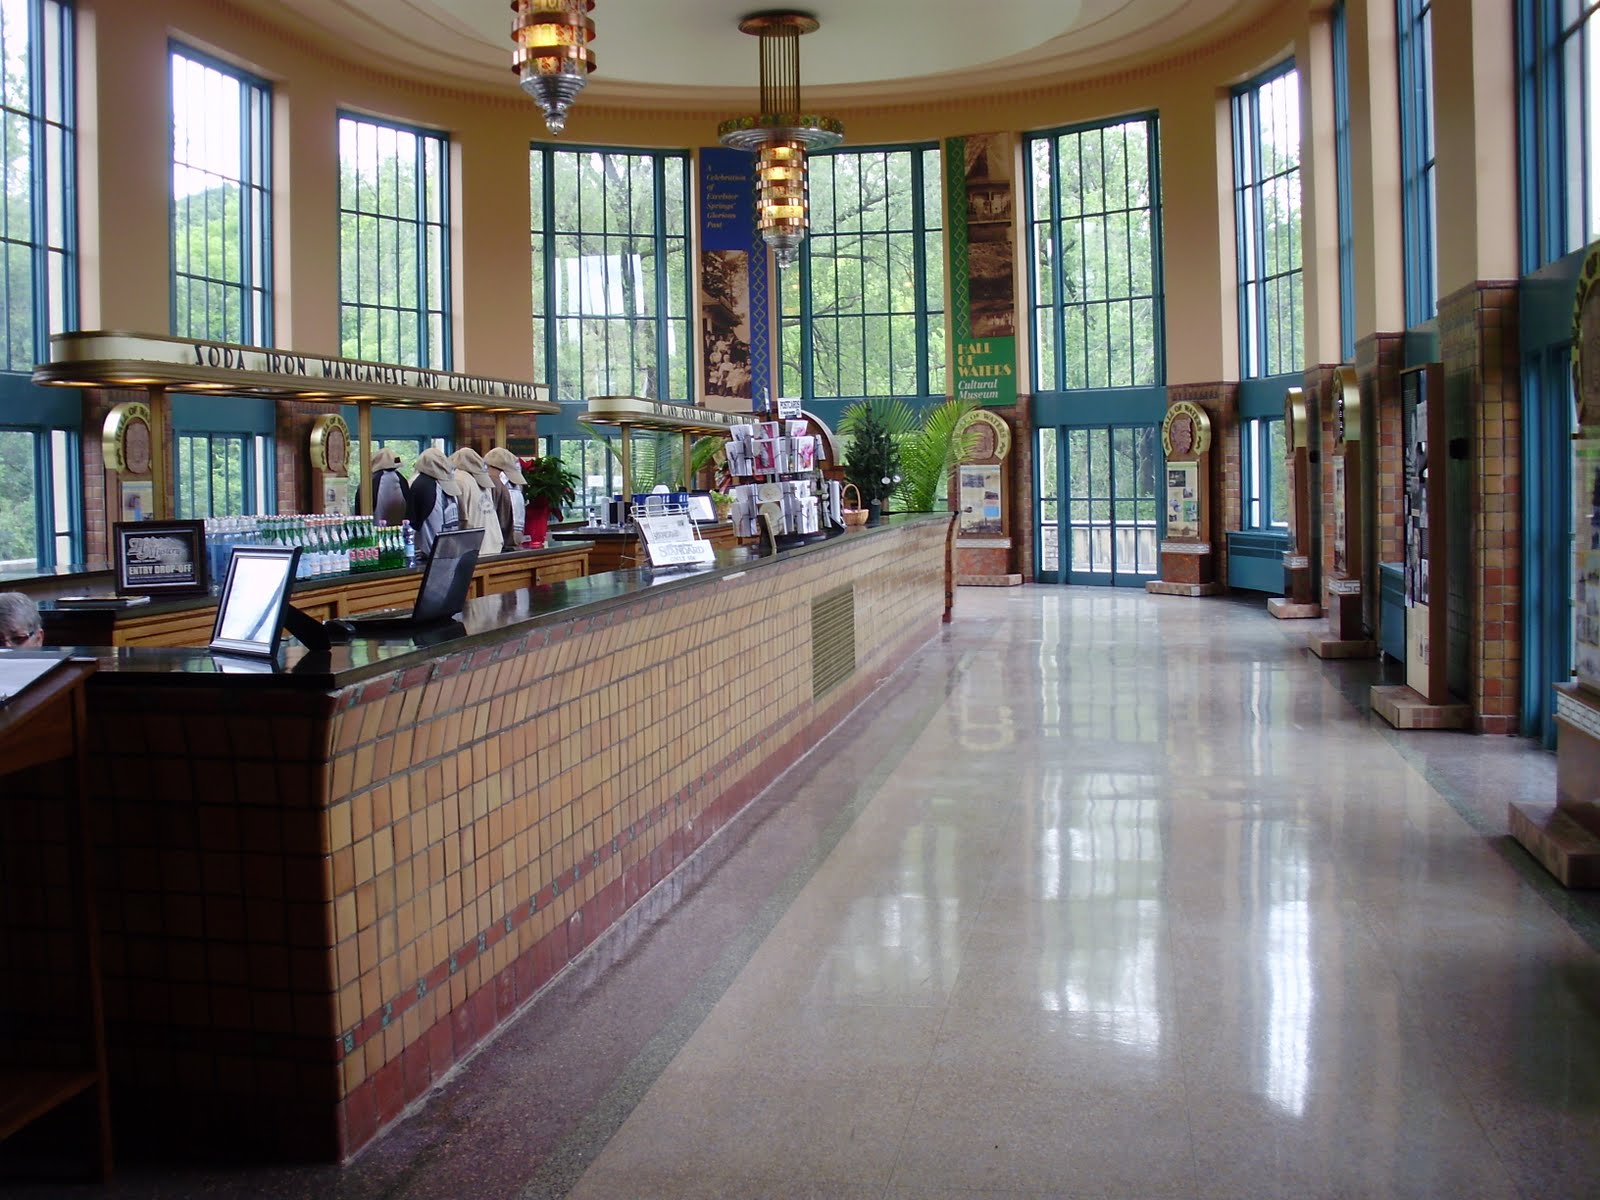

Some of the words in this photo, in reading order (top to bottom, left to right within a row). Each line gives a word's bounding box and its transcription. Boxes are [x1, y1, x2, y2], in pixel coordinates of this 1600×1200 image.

[957, 342, 992, 355] HALL
[957, 354, 975, 366] OF
[194, 344, 246, 371] SODA
[265, 352, 306, 376] IRON
[321, 358, 407, 387] MANGANESE
[416, 370, 438, 389] AND
[448, 376, 495, 396] CALCIUM
[502, 382, 538, 400] WATERS
[957, 364, 1012, 377] WATERS
[958, 379, 998, 390] Cultural
[958, 390, 999, 400] Museum
[129, 565, 153, 575] ENTRY
[154, 563, 192, 574] DROP-OFF
